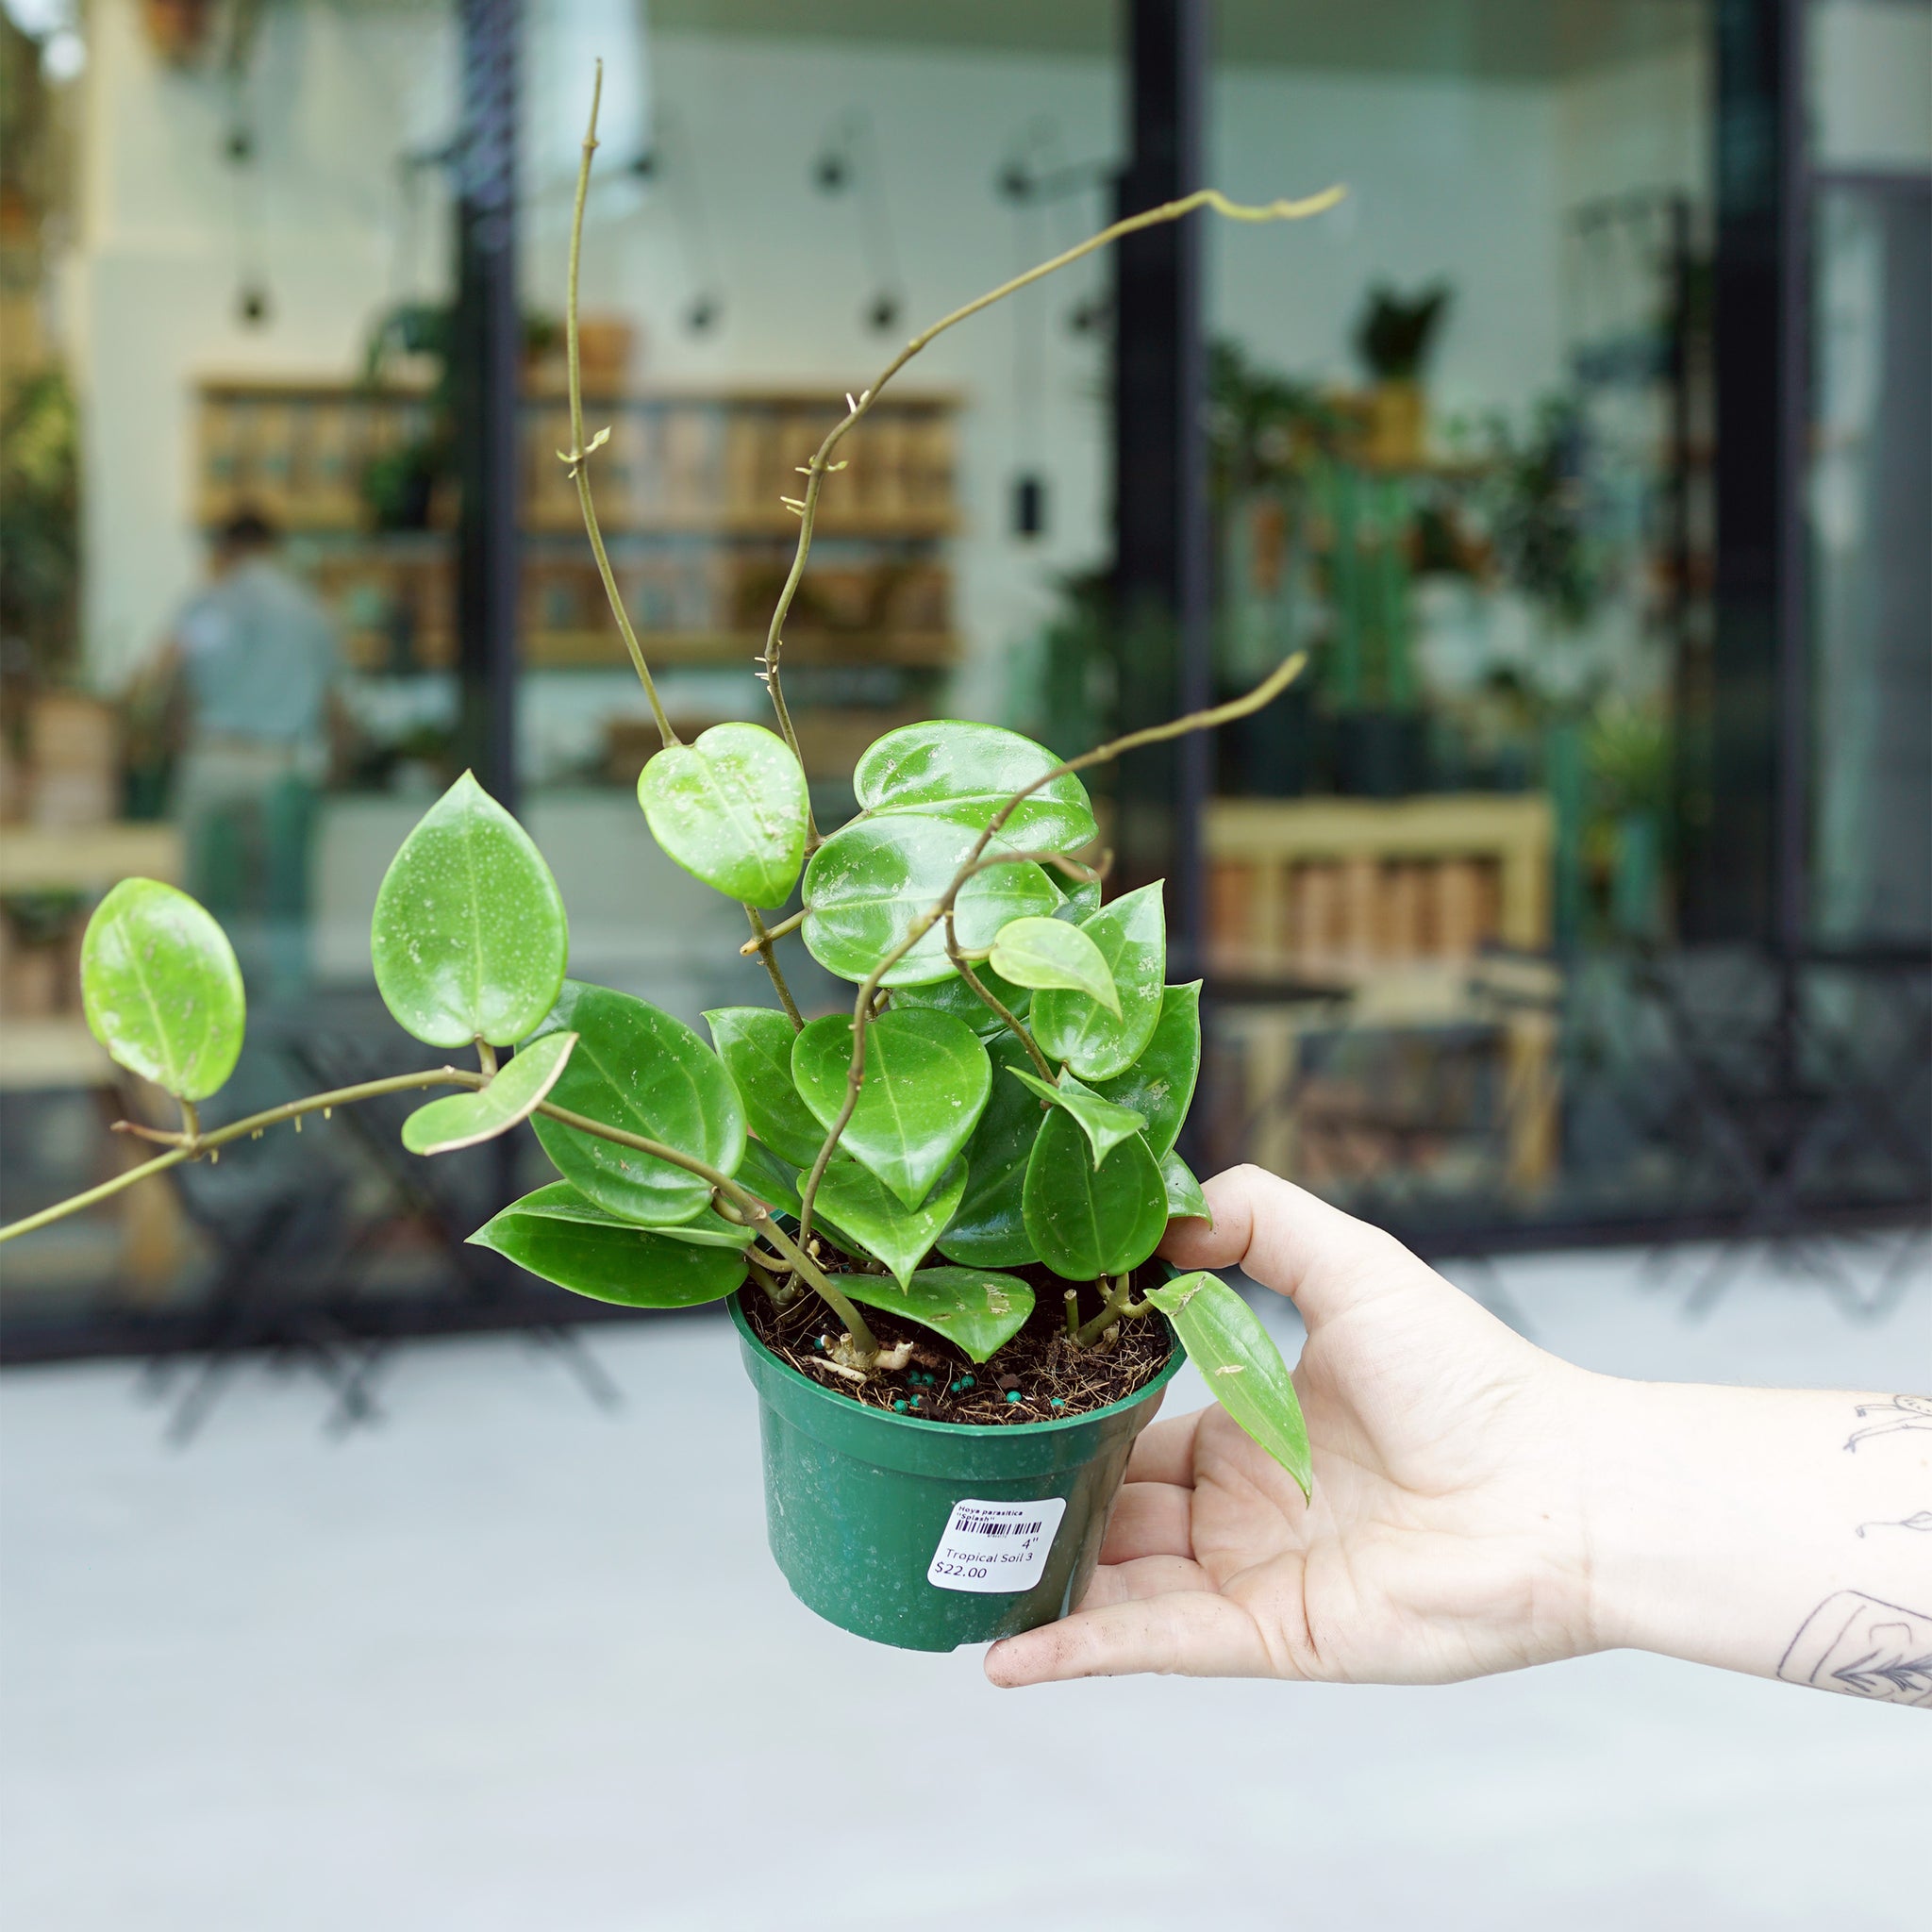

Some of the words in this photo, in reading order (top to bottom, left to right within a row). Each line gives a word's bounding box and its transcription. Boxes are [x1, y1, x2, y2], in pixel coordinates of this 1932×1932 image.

[958, 1506, 980, 1514] Hoya
[1022, 1537, 1039, 1549] 4"
[946, 1548, 998, 1563] Tropical
[1001, 1553, 1024, 1563] Soil
[1025, 1552, 1033, 1561] 3
[934, 1561, 988, 1578] $22.00
